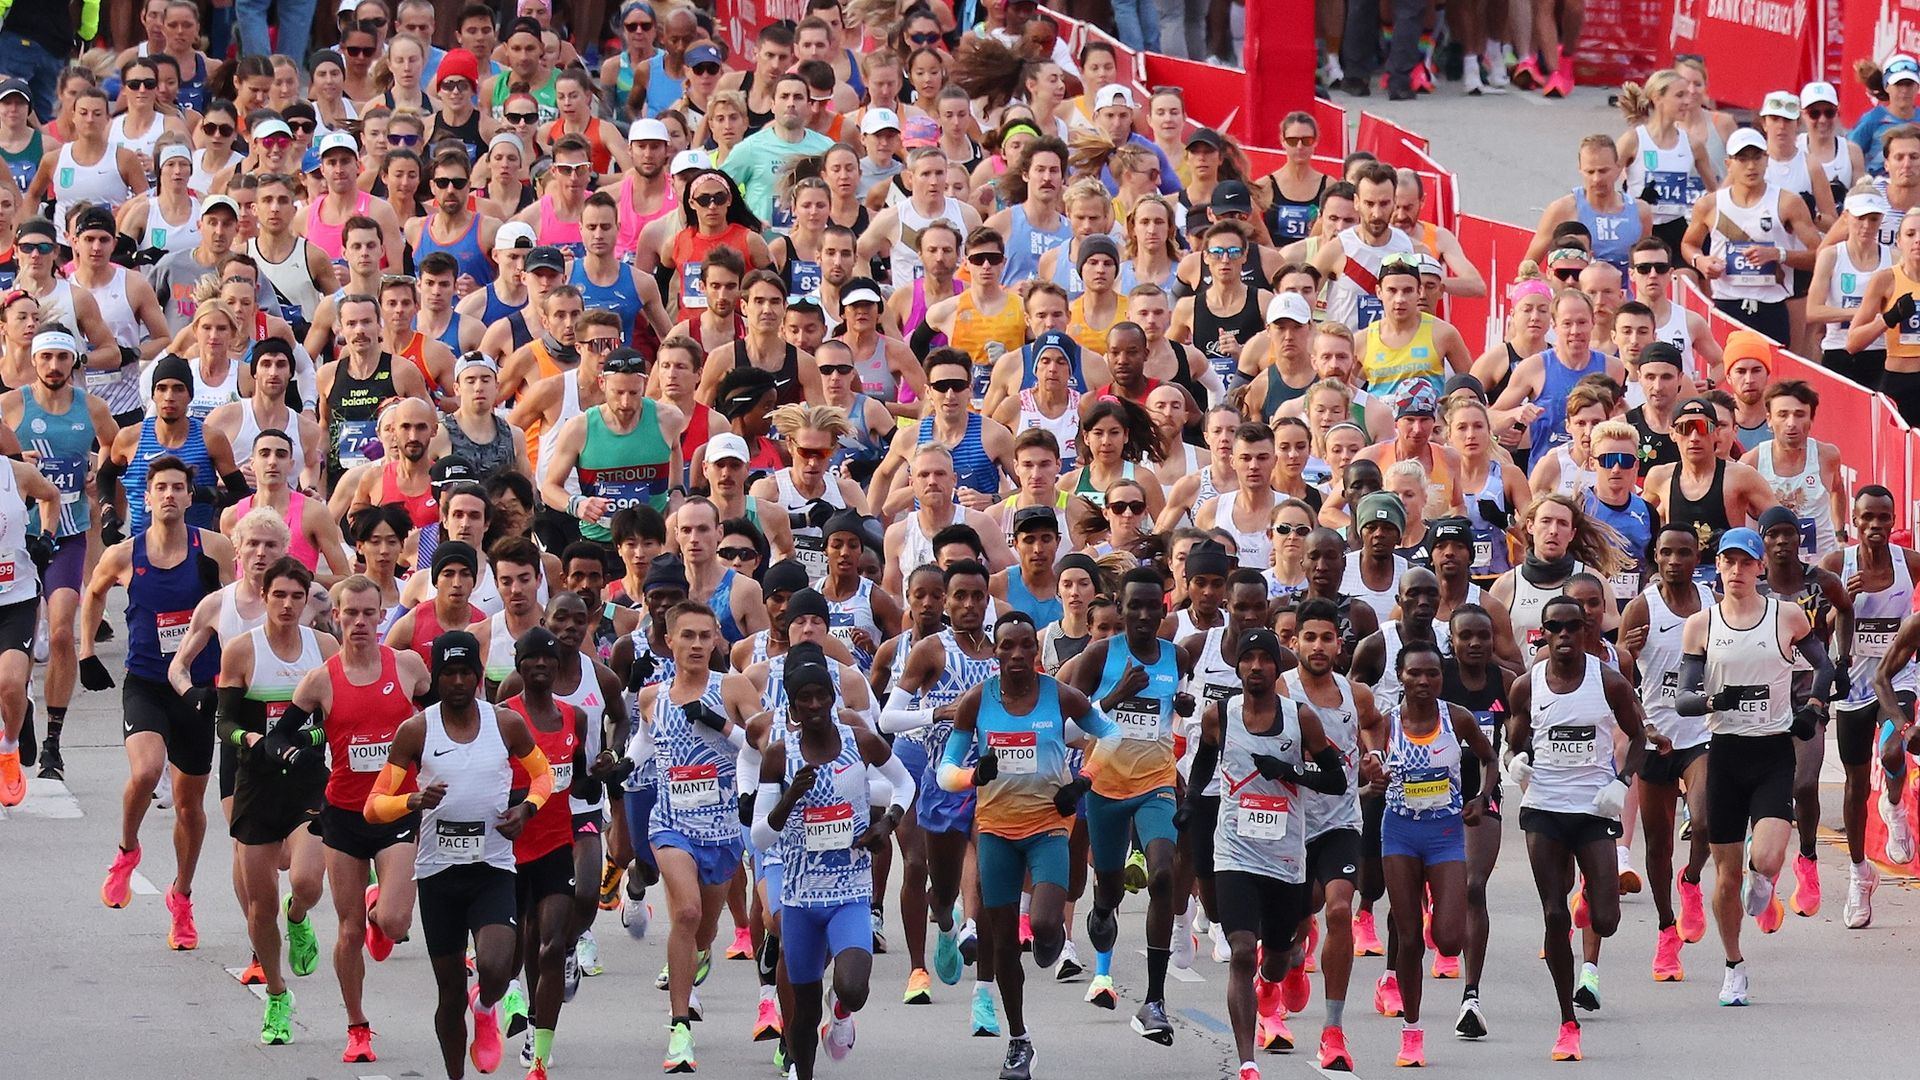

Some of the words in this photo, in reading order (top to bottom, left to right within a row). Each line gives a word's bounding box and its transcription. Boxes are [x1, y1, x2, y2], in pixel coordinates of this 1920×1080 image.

[1287, 220, 1306, 234] 51
[800, 276, 821, 290] 83
[350, 389, 369, 398] new
[341, 396, 379, 407] balance
[596, 467, 657, 481] STROUD
[796, 551, 816, 562] ACE
[1609, 576, 1628, 585] ACE
[1521, 598, 1539, 606] ZAP
[1715, 638, 1734, 646] ZAP
[1858, 634, 1889, 644] PACE
[1155, 674, 1173, 683] HOKA
[1760, 701, 1767, 712] 8
[1115, 711, 1147, 725] PACE
[1150, 713, 1157, 726] 5
[1031, 720, 1053, 730] HOKA
[1552, 742, 1583, 753] PACE
[1587, 741, 1594, 752] 6
[996, 748, 1036, 760] IPTOO
[671, 780, 716, 796] MANTZ
[1247, 811, 1278, 825] ABDI
[806, 821, 853, 836] KIPTUM
[438, 837, 470, 849] PACE
[475, 837, 480, 848] 1
